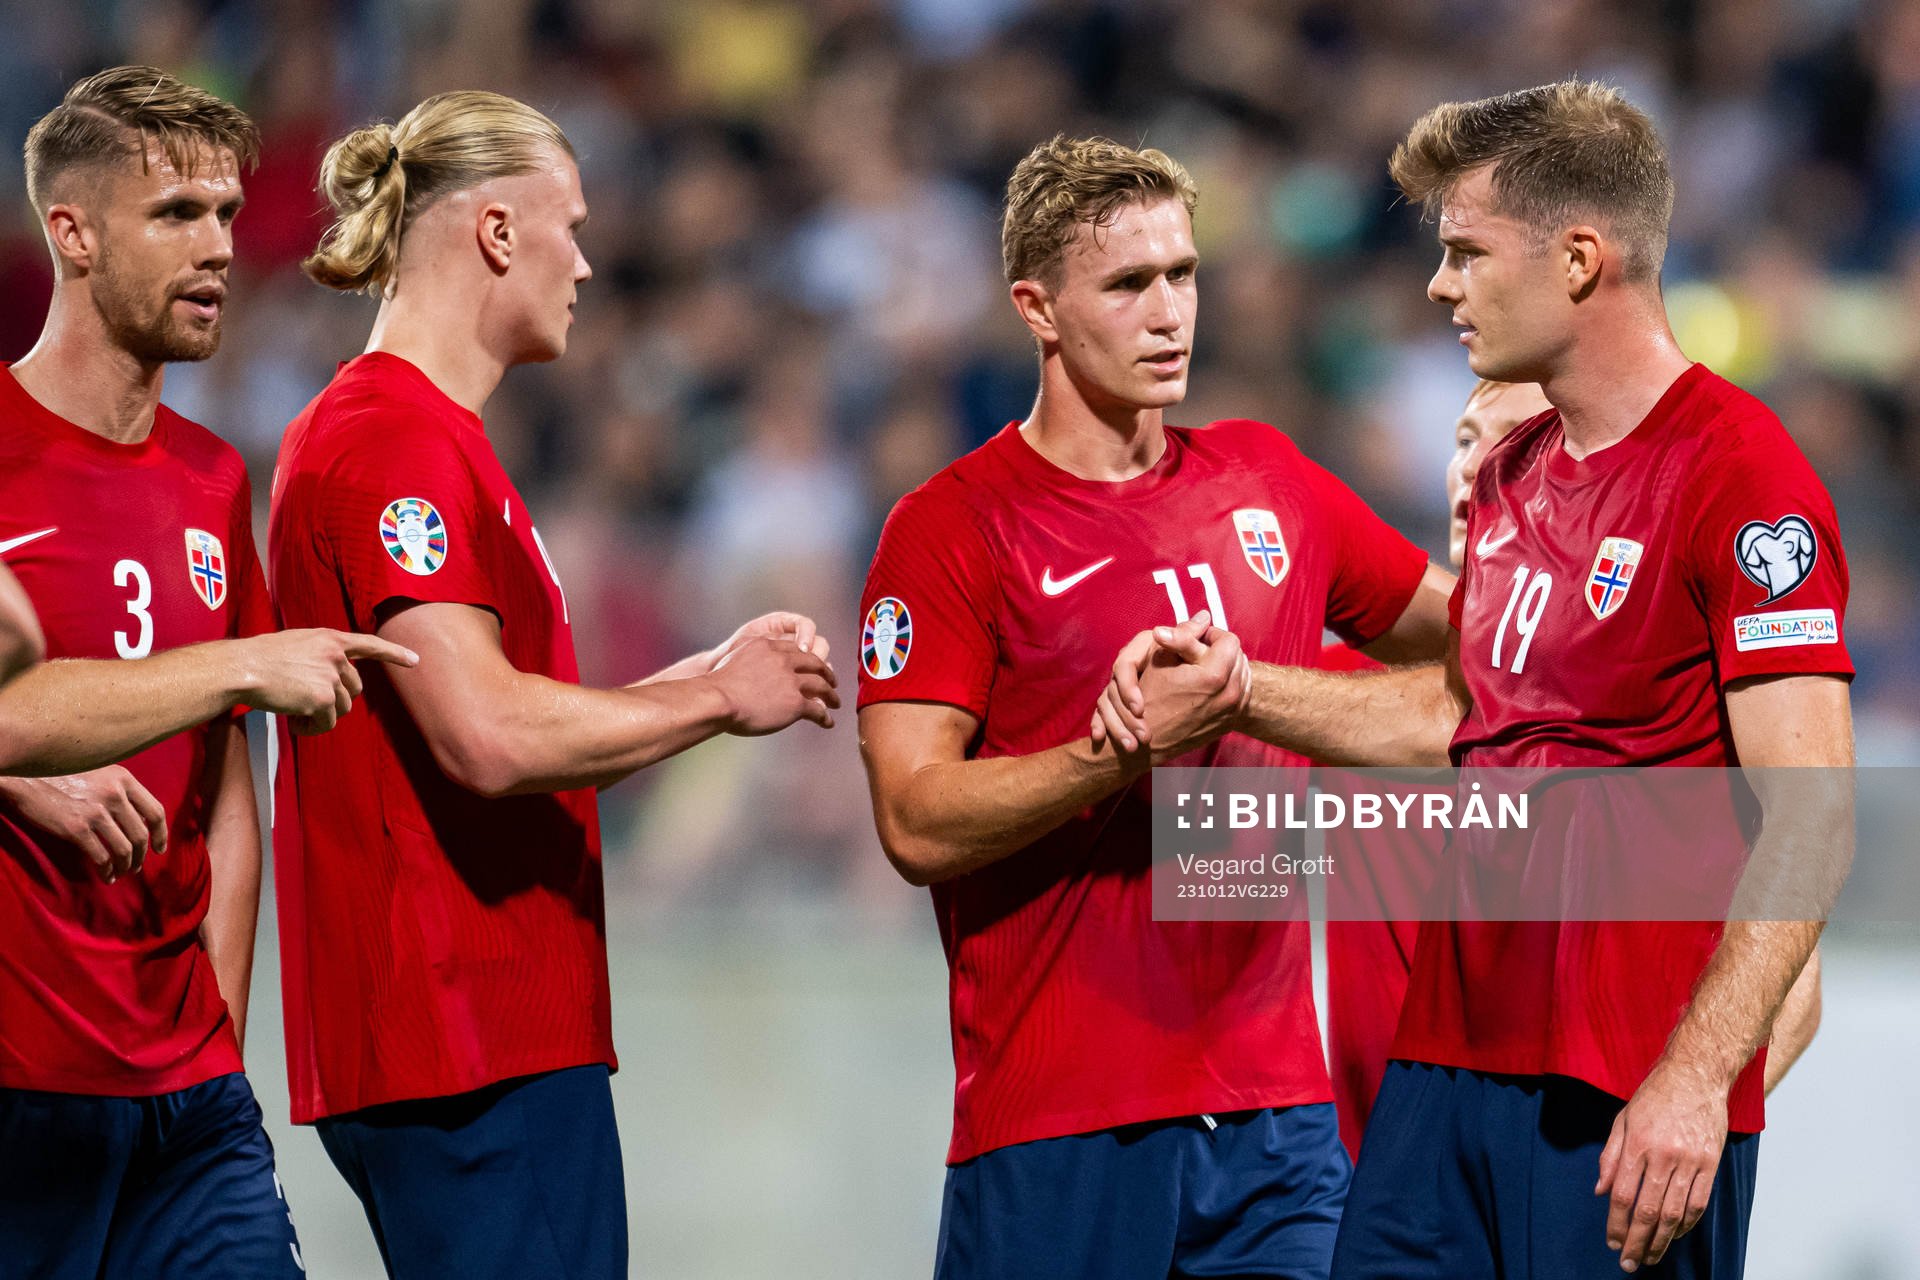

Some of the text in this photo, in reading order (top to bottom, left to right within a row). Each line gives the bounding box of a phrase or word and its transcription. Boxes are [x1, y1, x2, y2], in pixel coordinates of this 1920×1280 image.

[113, 559, 154, 660] 3
[1152, 563, 1229, 631] 11
[1491, 564, 1553, 675] 19
[1737, 616, 1760, 626] UEFA
